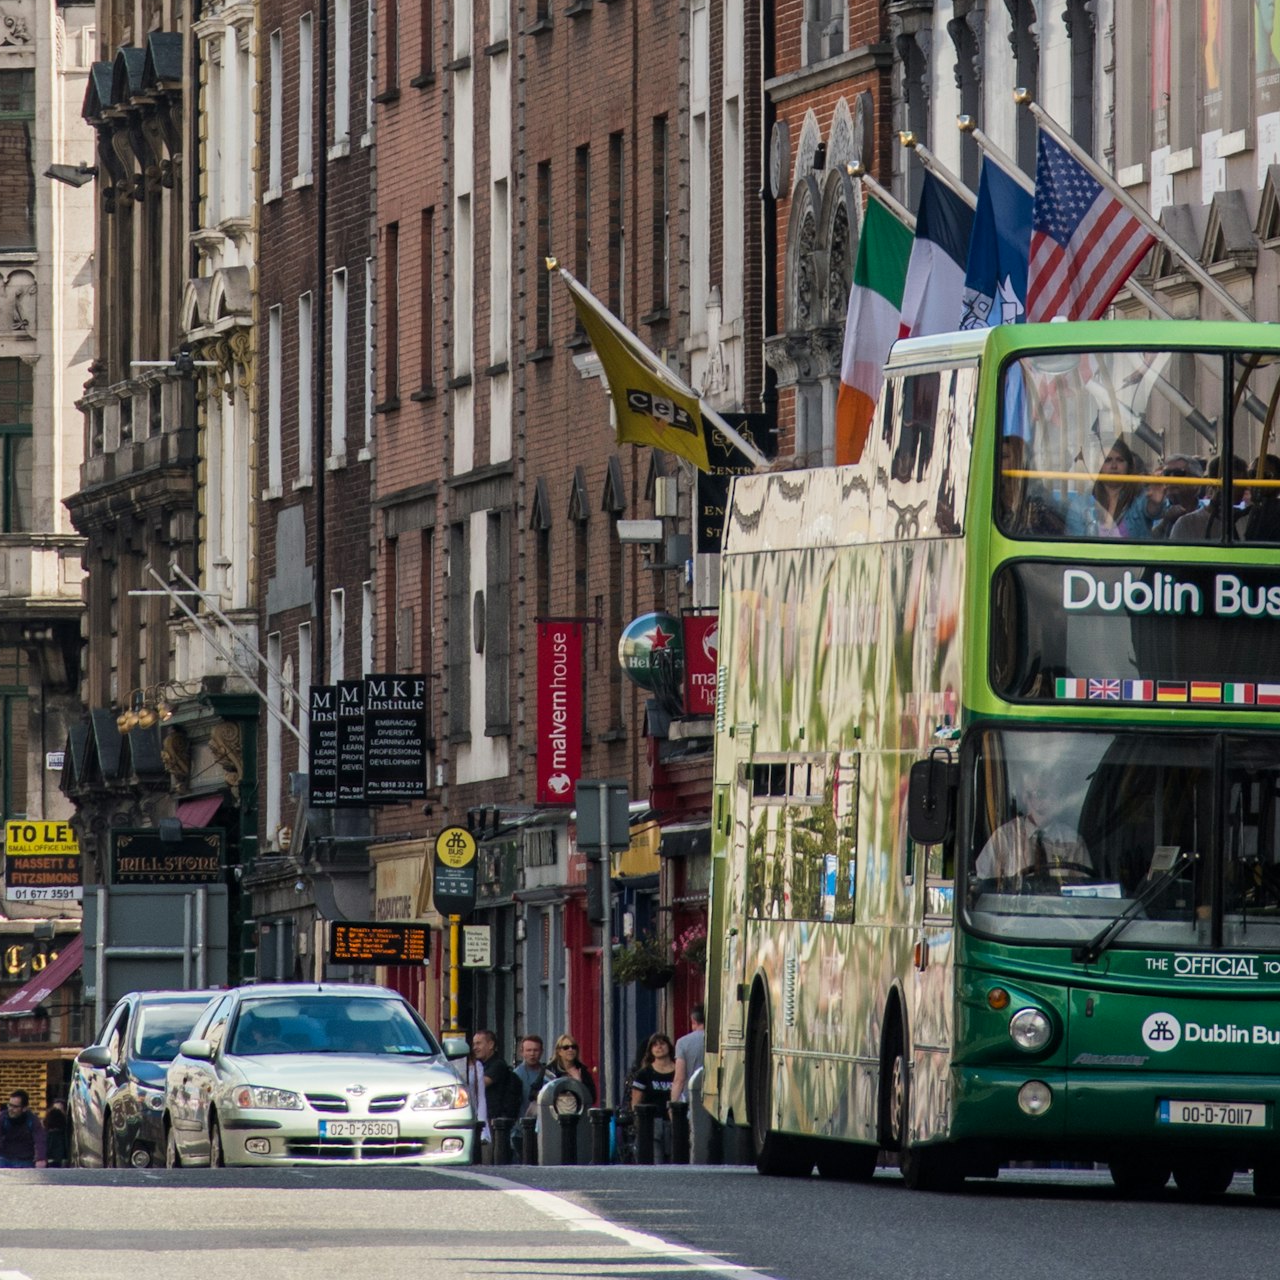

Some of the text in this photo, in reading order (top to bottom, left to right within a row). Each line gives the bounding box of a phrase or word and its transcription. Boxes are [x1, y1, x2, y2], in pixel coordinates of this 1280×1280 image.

[1063, 569, 1200, 612] Dublin
[367, 698, 424, 710] Institute
[10, 825, 38, 843] TO
[8, 844, 34, 852] SMALL
[34, 844, 60, 852] OFFICE
[14, 858, 76, 870] HASSETT &
[117, 856, 219, 871] MILLSTONE
[11, 873, 79, 884] FITZSIMONS
[15, 890, 74, 899] 01 677 3591
[1145, 957, 1169, 971] THE
[1174, 956, 1259, 976] OFFICIAL
[1184, 1022, 1250, 1044] Dublin
[1182, 1105, 1253, 1126] 00-D-70117
[330, 1123, 394, 1136] 02-D-26360
